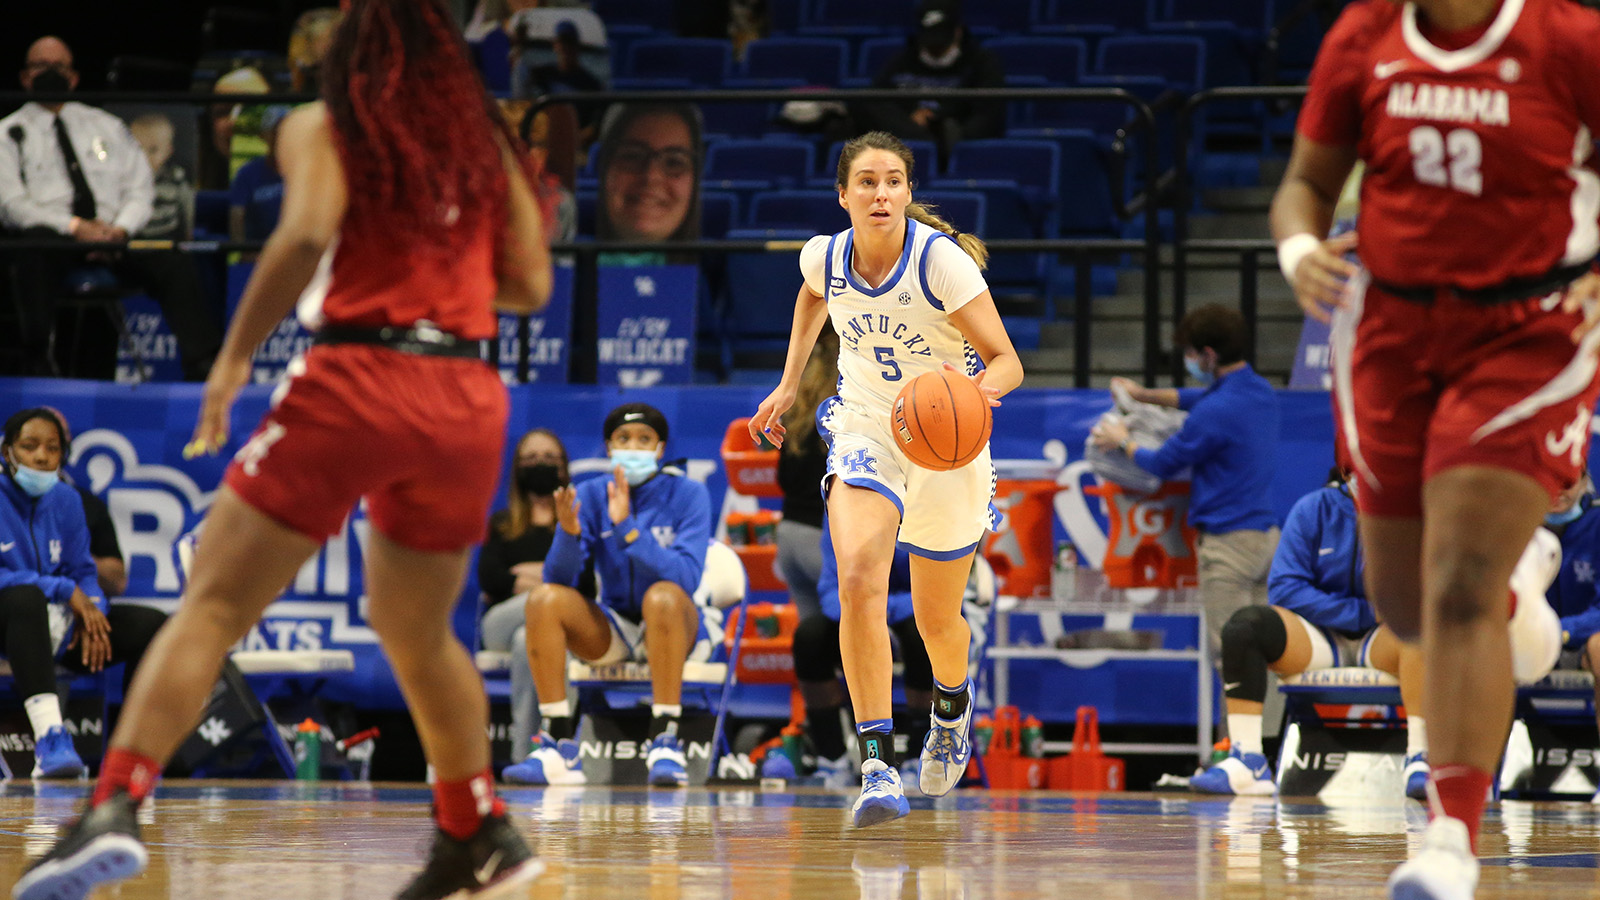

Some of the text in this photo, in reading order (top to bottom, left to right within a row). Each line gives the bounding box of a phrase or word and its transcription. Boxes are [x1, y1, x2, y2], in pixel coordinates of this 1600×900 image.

[1386, 83, 1510, 126] ALABAMA
[1408, 125, 1483, 196] 22
[598, 338, 689, 364] WILDCAT
[873, 346, 903, 381] 5
[840, 448, 877, 476] UK
[1134, 502, 1164, 534] G
[228, 620, 323, 651] ATS
[1301, 671, 1381, 685] KENTUCKY
[580, 740, 712, 759] NISN
